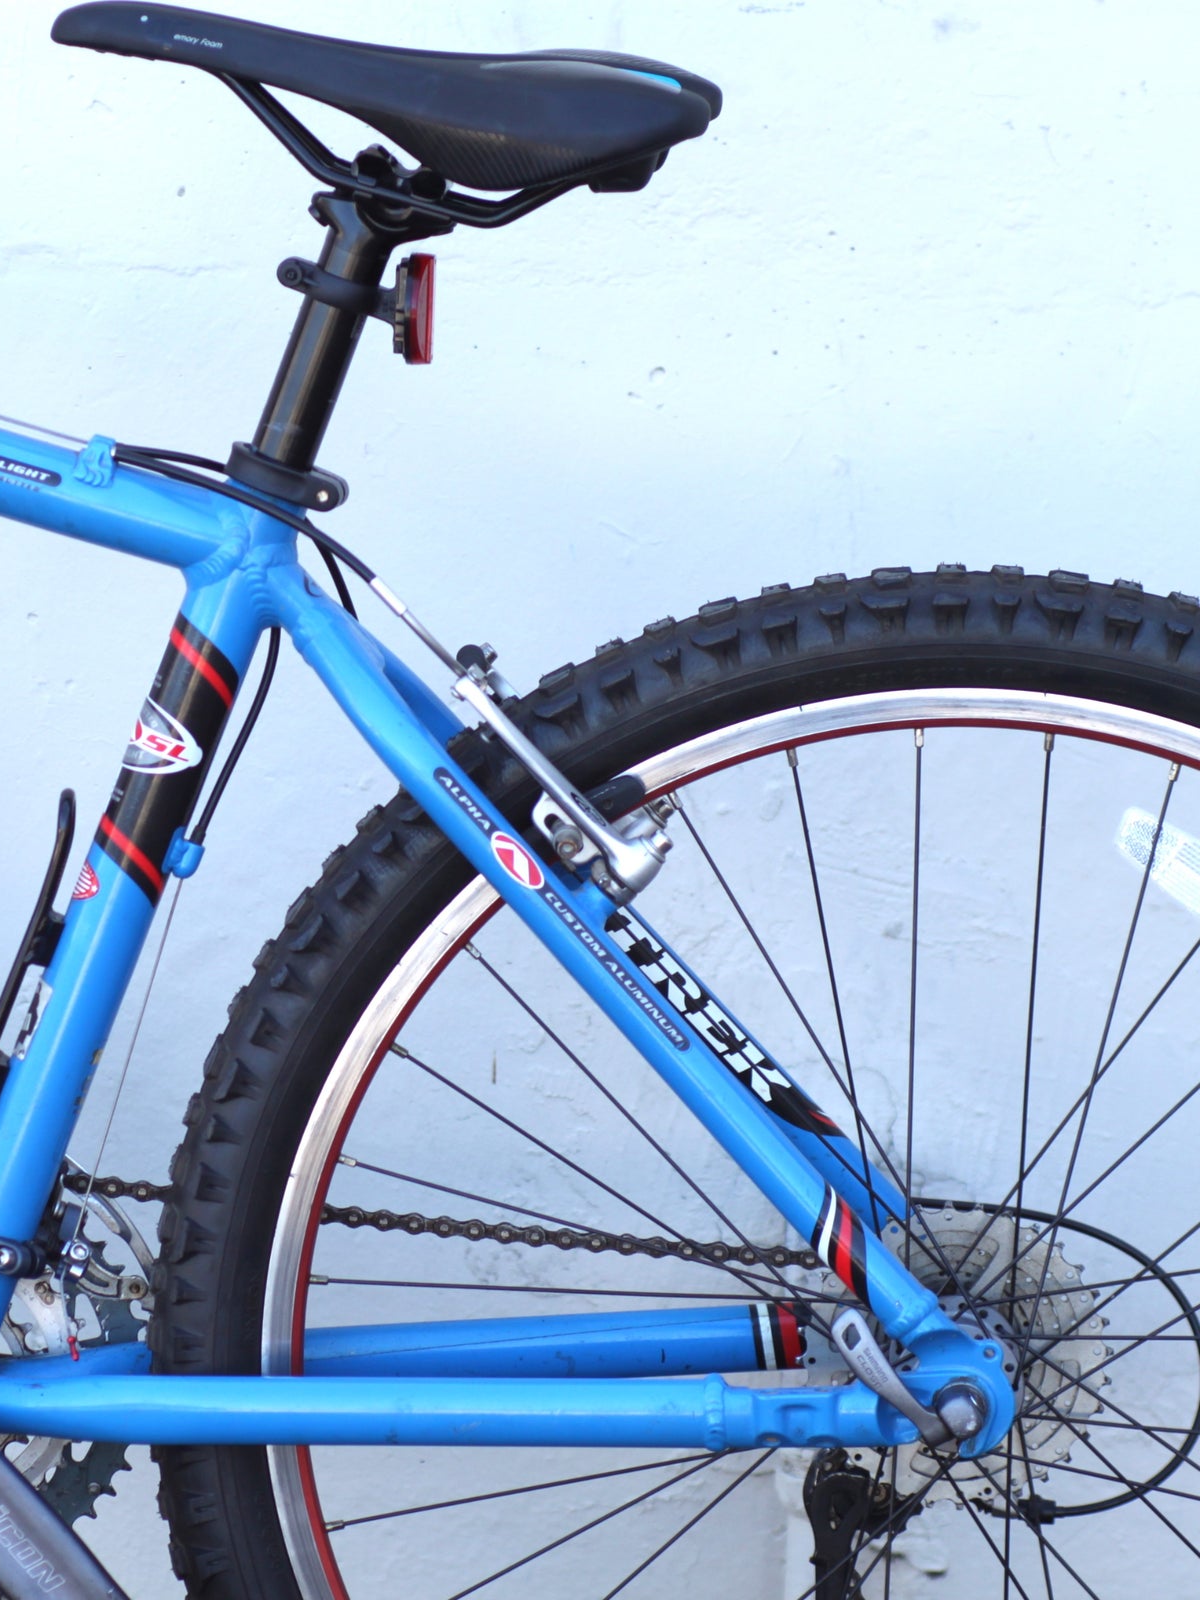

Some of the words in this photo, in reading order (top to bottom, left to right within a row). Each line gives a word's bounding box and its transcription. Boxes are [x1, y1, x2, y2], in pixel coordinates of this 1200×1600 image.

[142, 734, 189, 762] SL
[439, 775, 491, 831] ALPHA
[545, 892, 607, 958] CUSTOM
[605, 960, 684, 1043] ALUMINUM
[607, 905, 792, 1103] TREK
